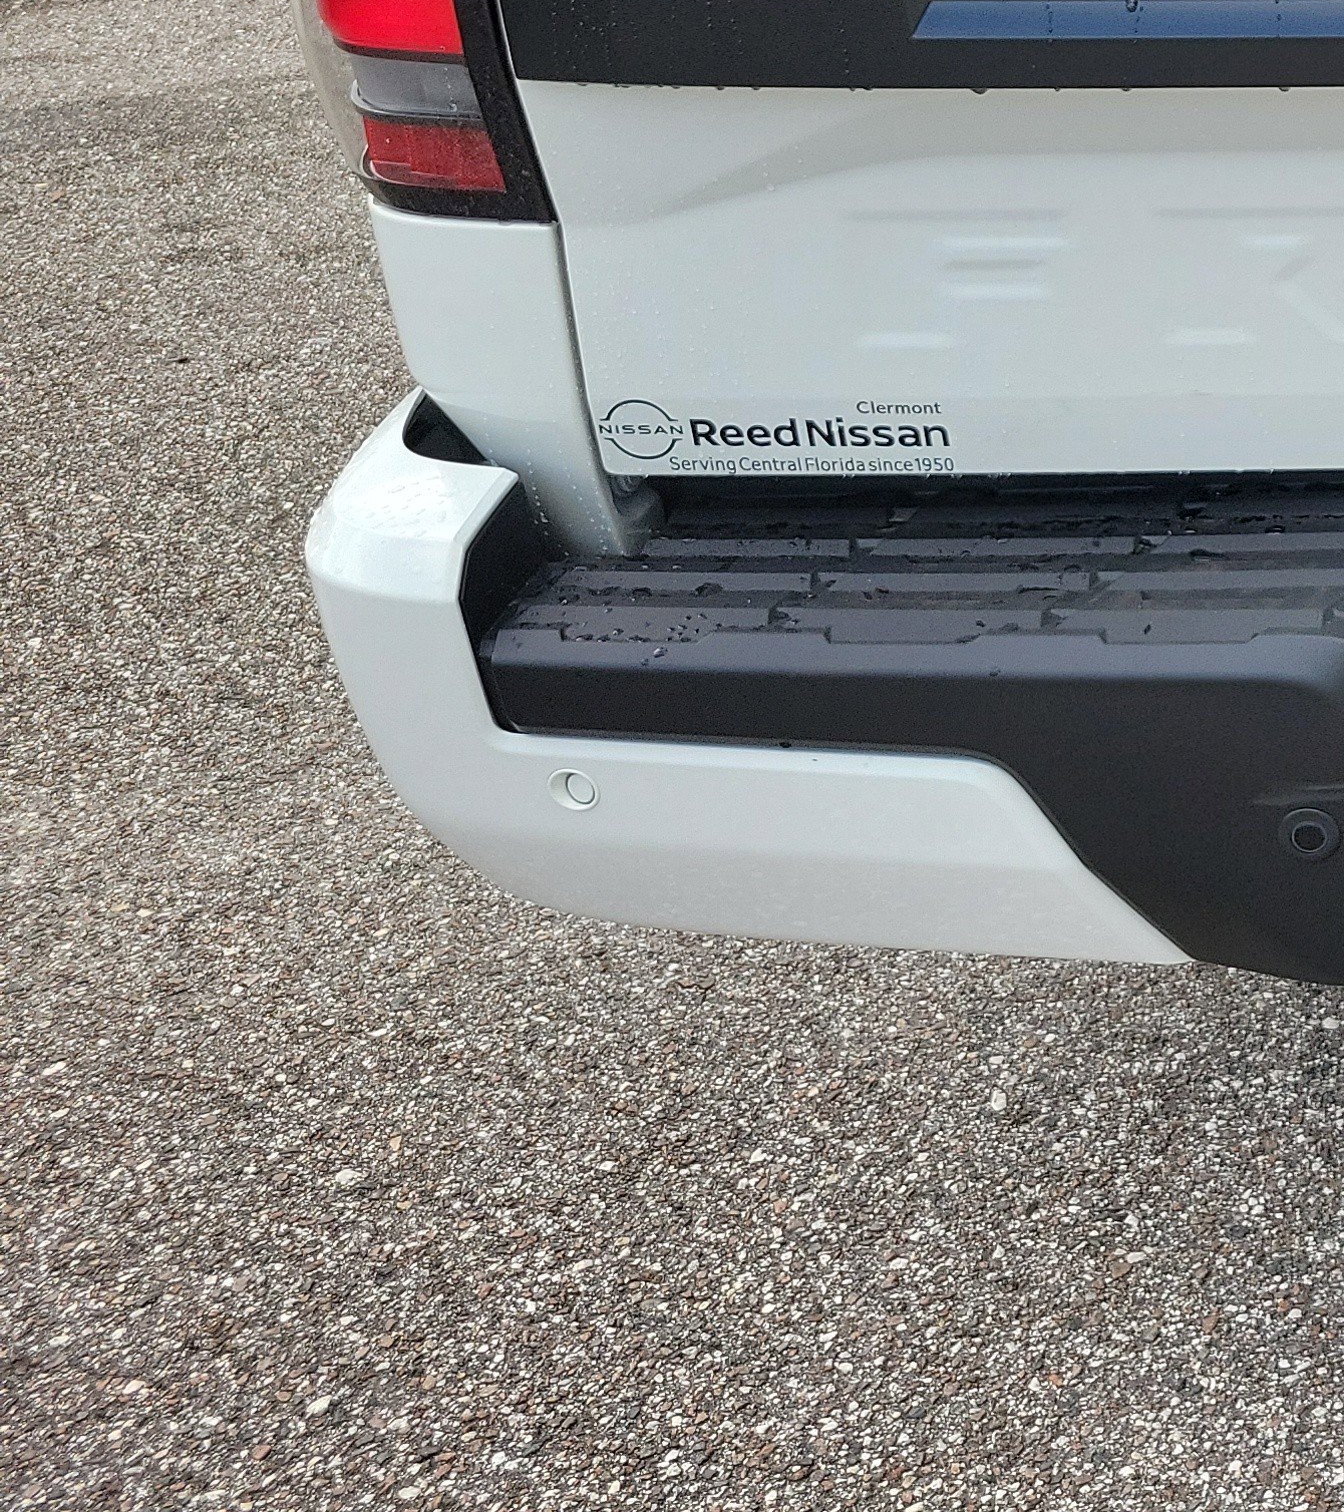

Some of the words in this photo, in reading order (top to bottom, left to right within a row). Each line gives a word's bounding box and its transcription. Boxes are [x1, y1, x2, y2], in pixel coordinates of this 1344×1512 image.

[856, 401, 942, 414] Clermont
[598, 424, 684, 435] NISSAN
[669, 456, 737, 474] Serving
[739, 456, 802, 472] Central
[805, 457, 866, 472] Florida
